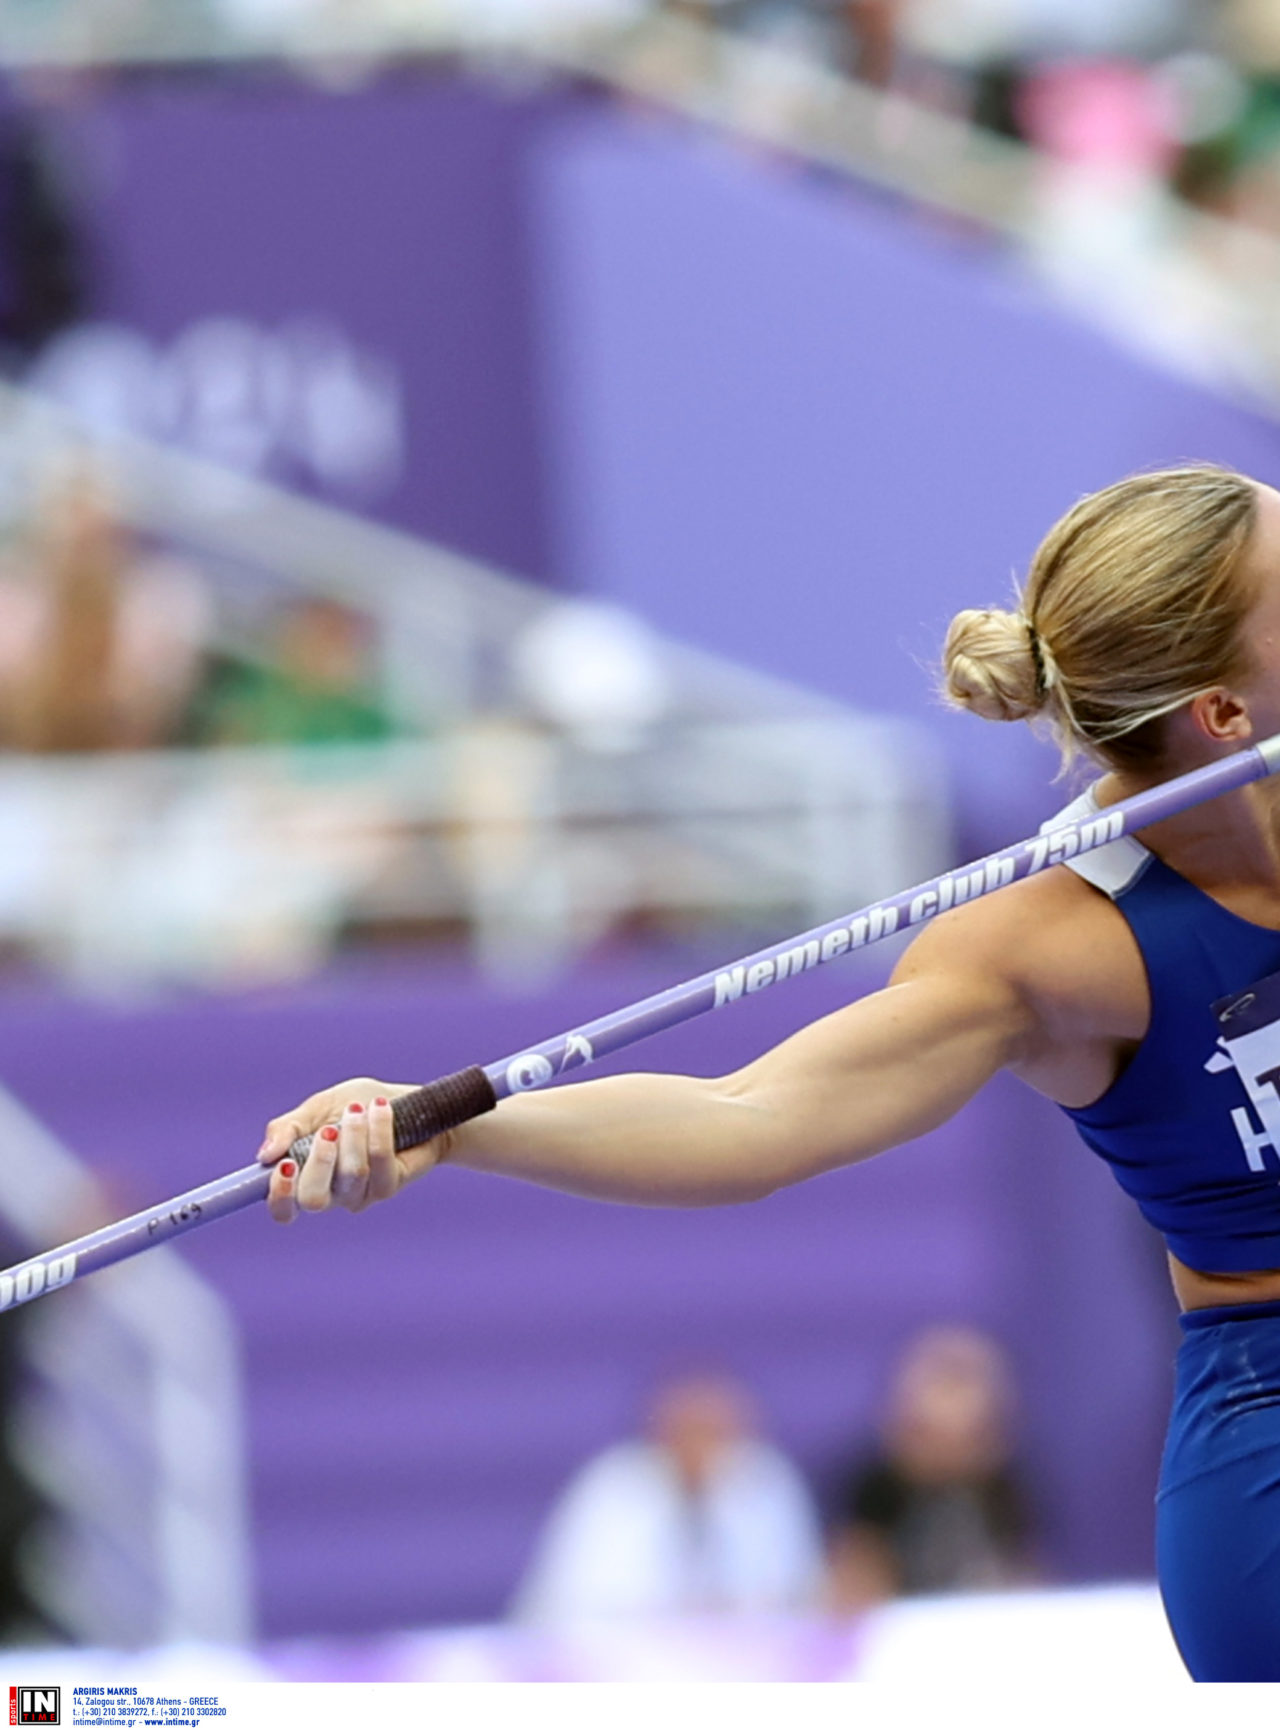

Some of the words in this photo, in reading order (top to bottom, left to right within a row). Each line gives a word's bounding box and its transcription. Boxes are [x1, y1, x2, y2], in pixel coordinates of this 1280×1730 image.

[713, 907, 899, 1009] Nemeth
[910, 855, 1016, 923] club
[1025, 810, 1125, 876] 75m
